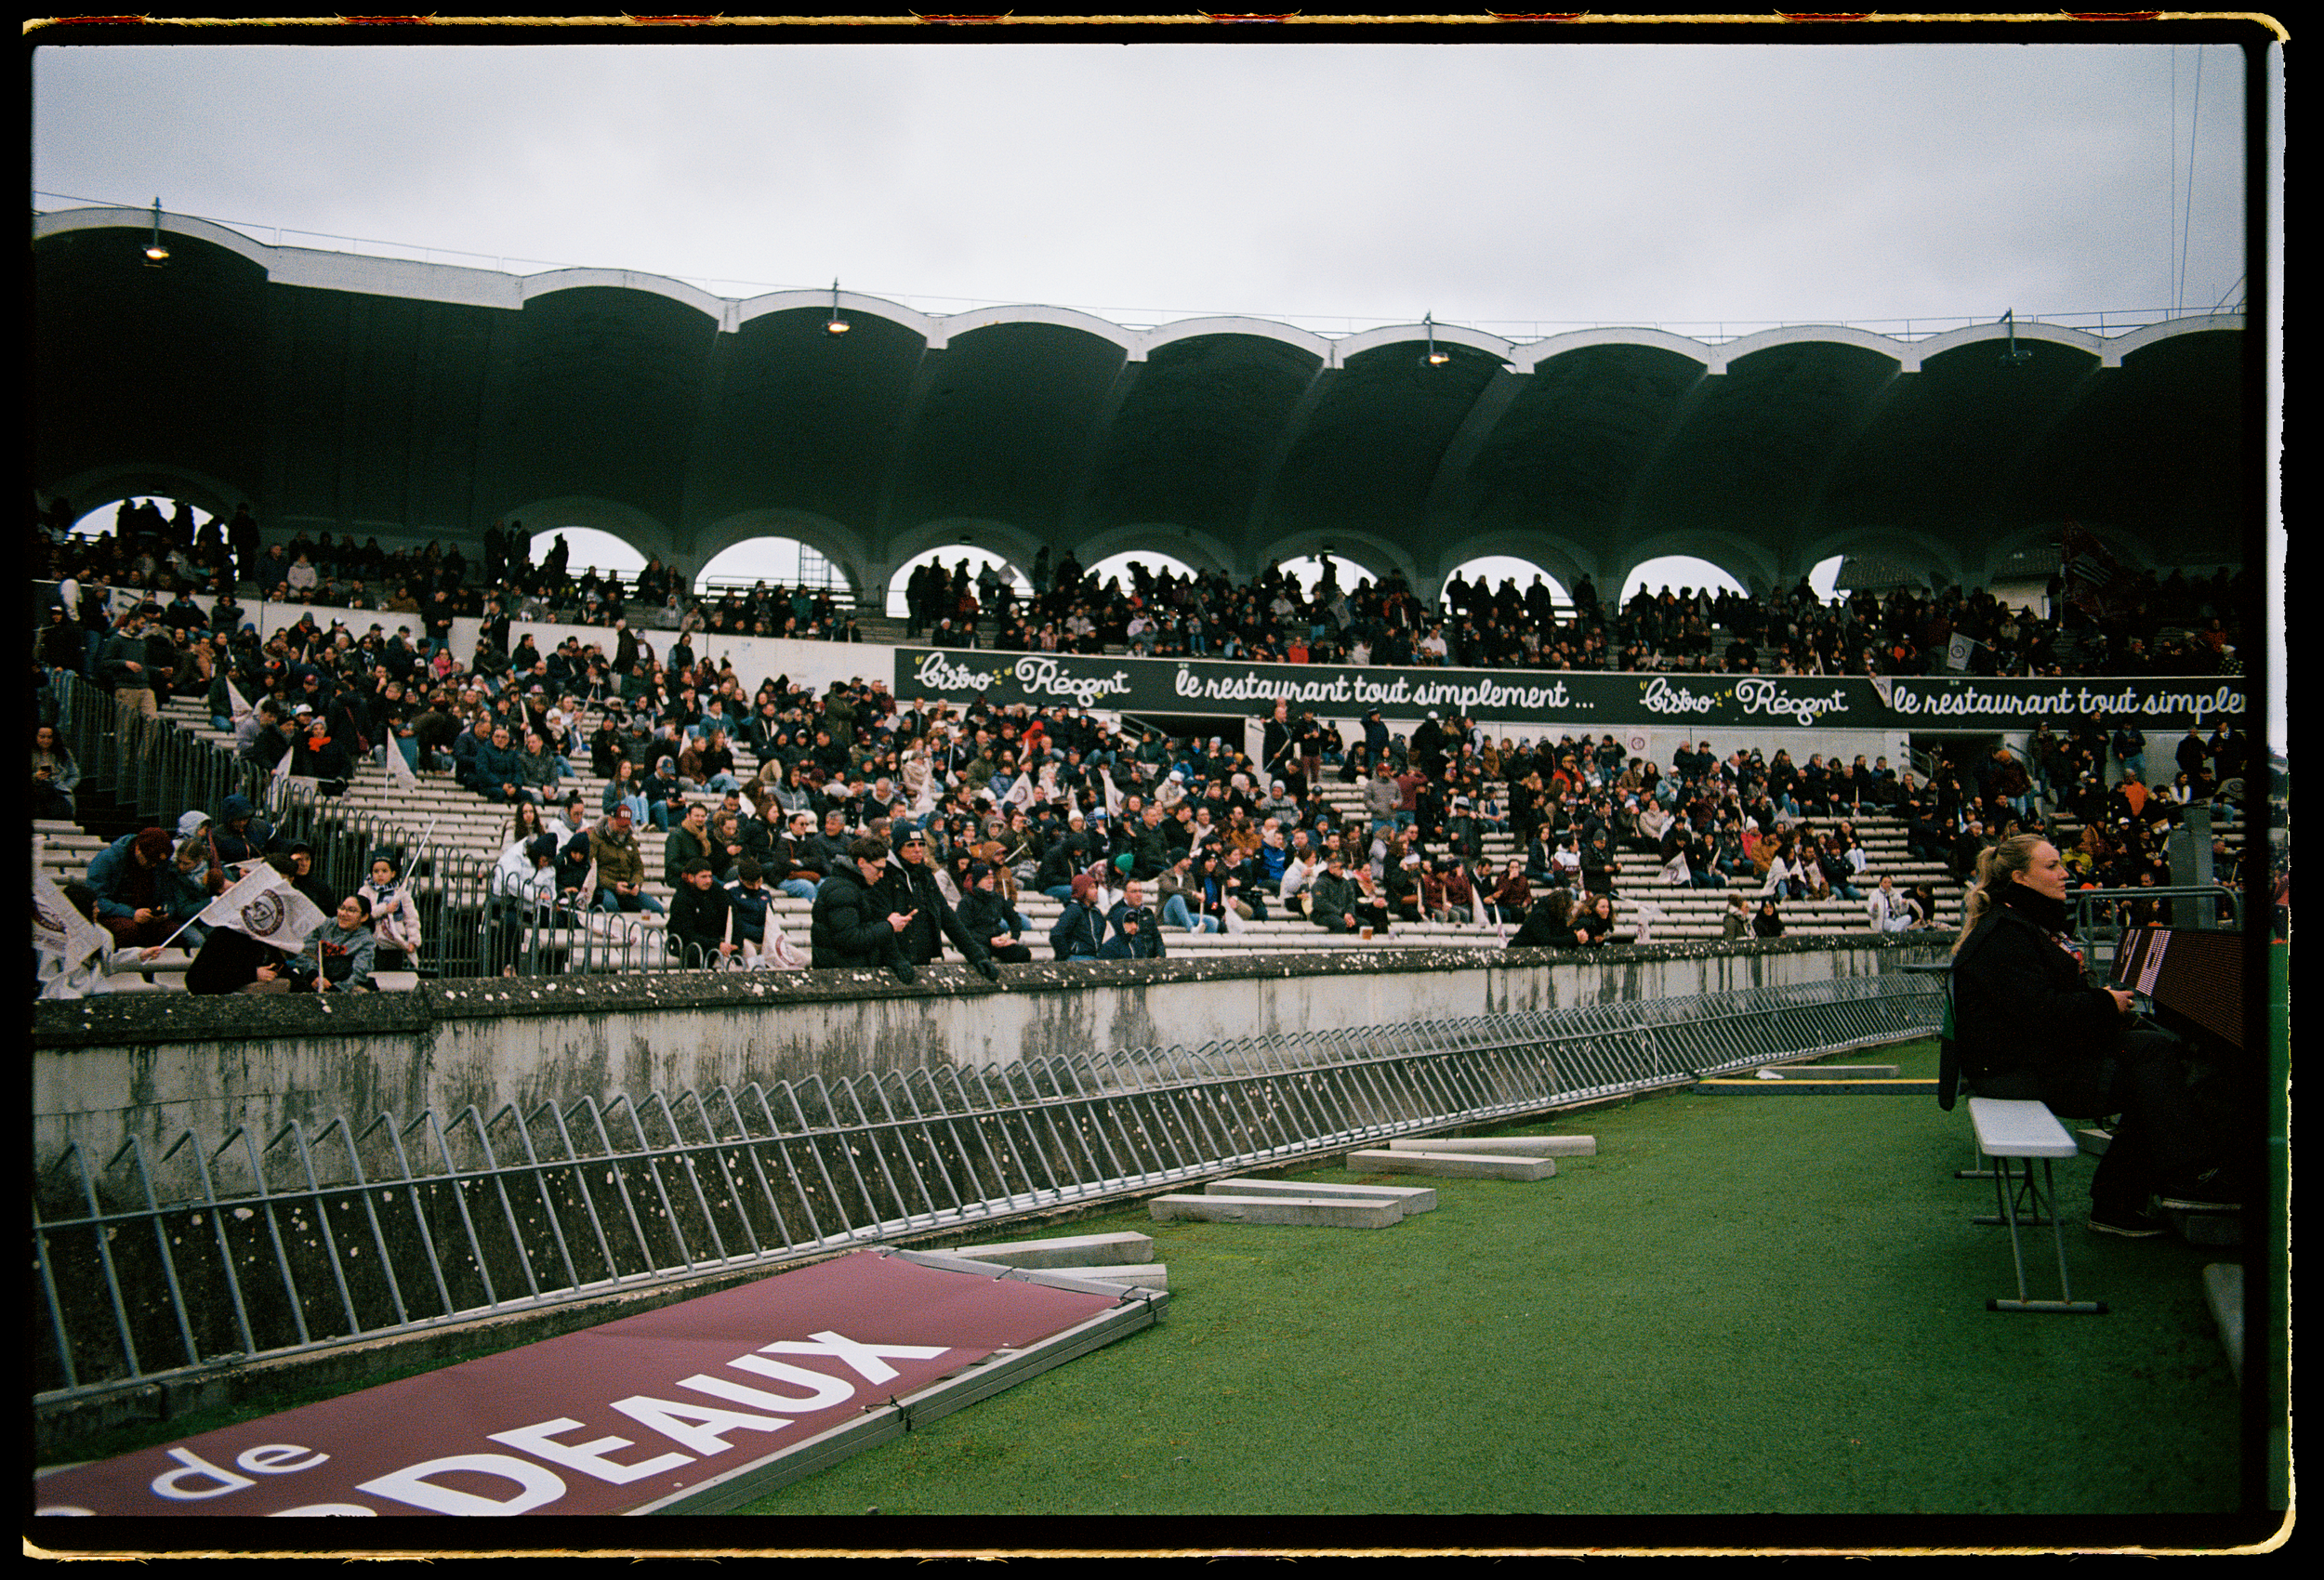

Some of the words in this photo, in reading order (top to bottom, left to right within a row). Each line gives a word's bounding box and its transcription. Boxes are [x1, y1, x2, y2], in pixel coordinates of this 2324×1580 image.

[1015, 656, 1130, 707] Régent
[1175, 668, 1203, 697] le
[1205, 671, 1352, 704] restaurant
[1353, 675, 1411, 704] tout
[1736, 678, 1848, 726] Régent
[1894, 685, 1921, 714] le
[1923, 686, 2075, 716] restaurant
[2078, 687, 2140, 715] tout
[2141, 686, 2247, 725] simple
[264, 1330, 952, 1516] DEAUX
[150, 1443, 330, 1500] de
